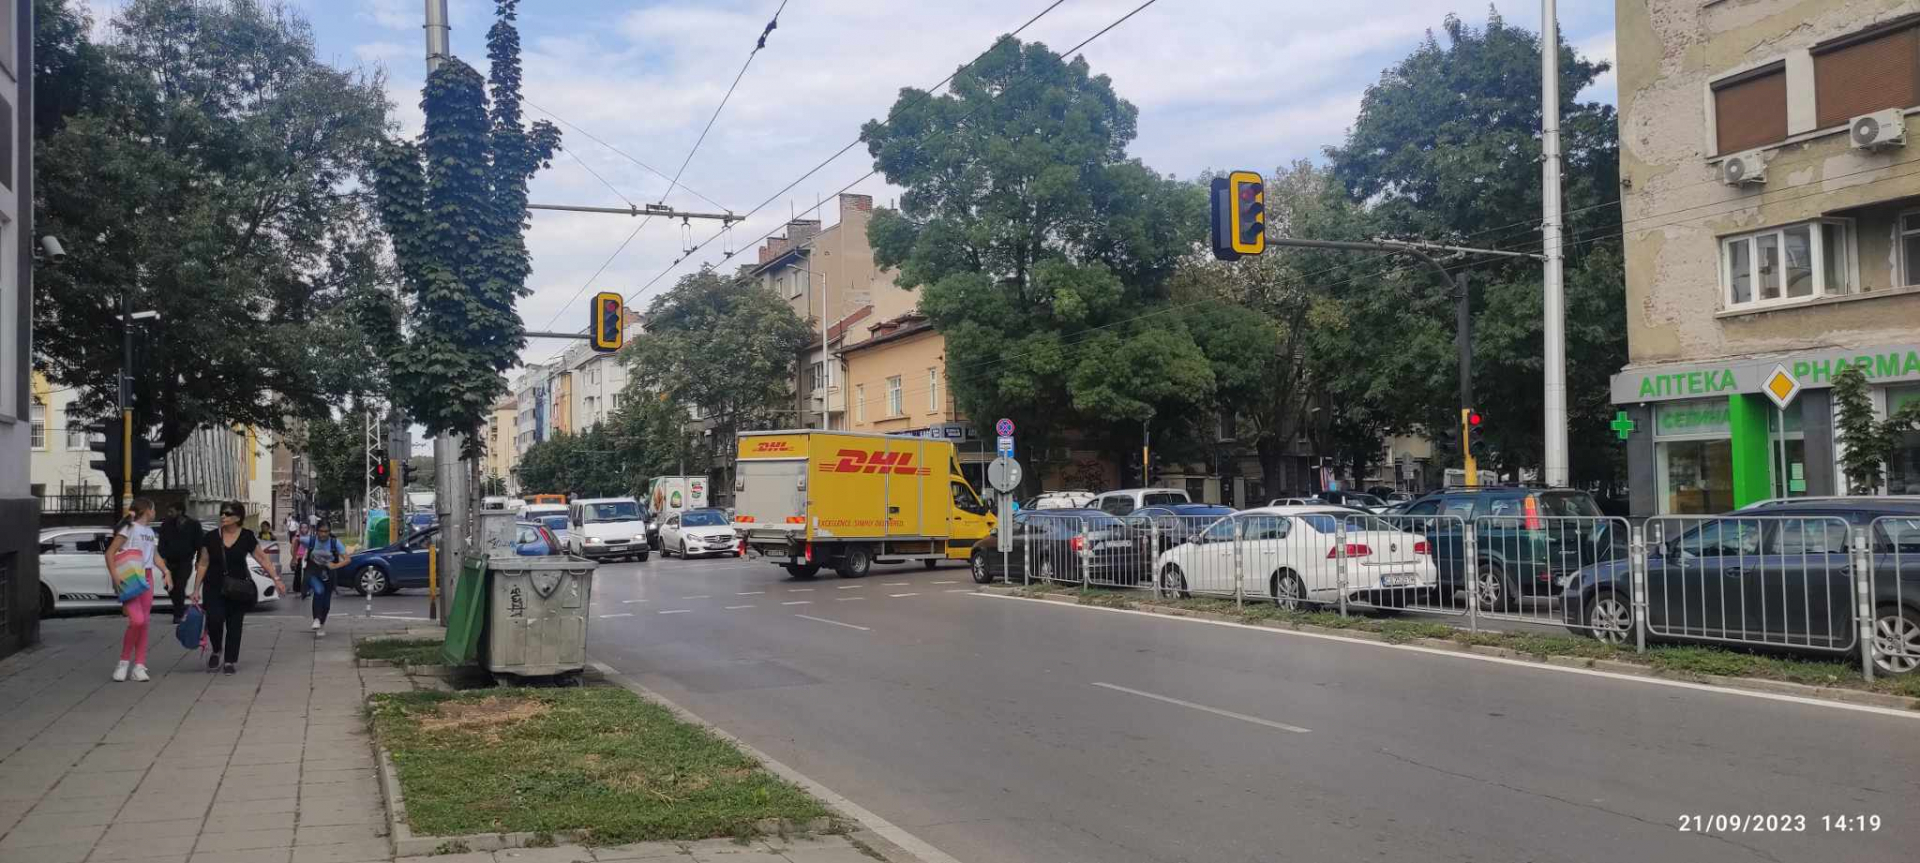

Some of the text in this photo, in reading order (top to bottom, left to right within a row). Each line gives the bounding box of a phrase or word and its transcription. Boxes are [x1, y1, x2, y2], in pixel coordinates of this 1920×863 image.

[1639, 368, 1738, 398] АПТЕКА
[757, 441, 790, 452] DHL
[834, 449, 919, 476] DHL
